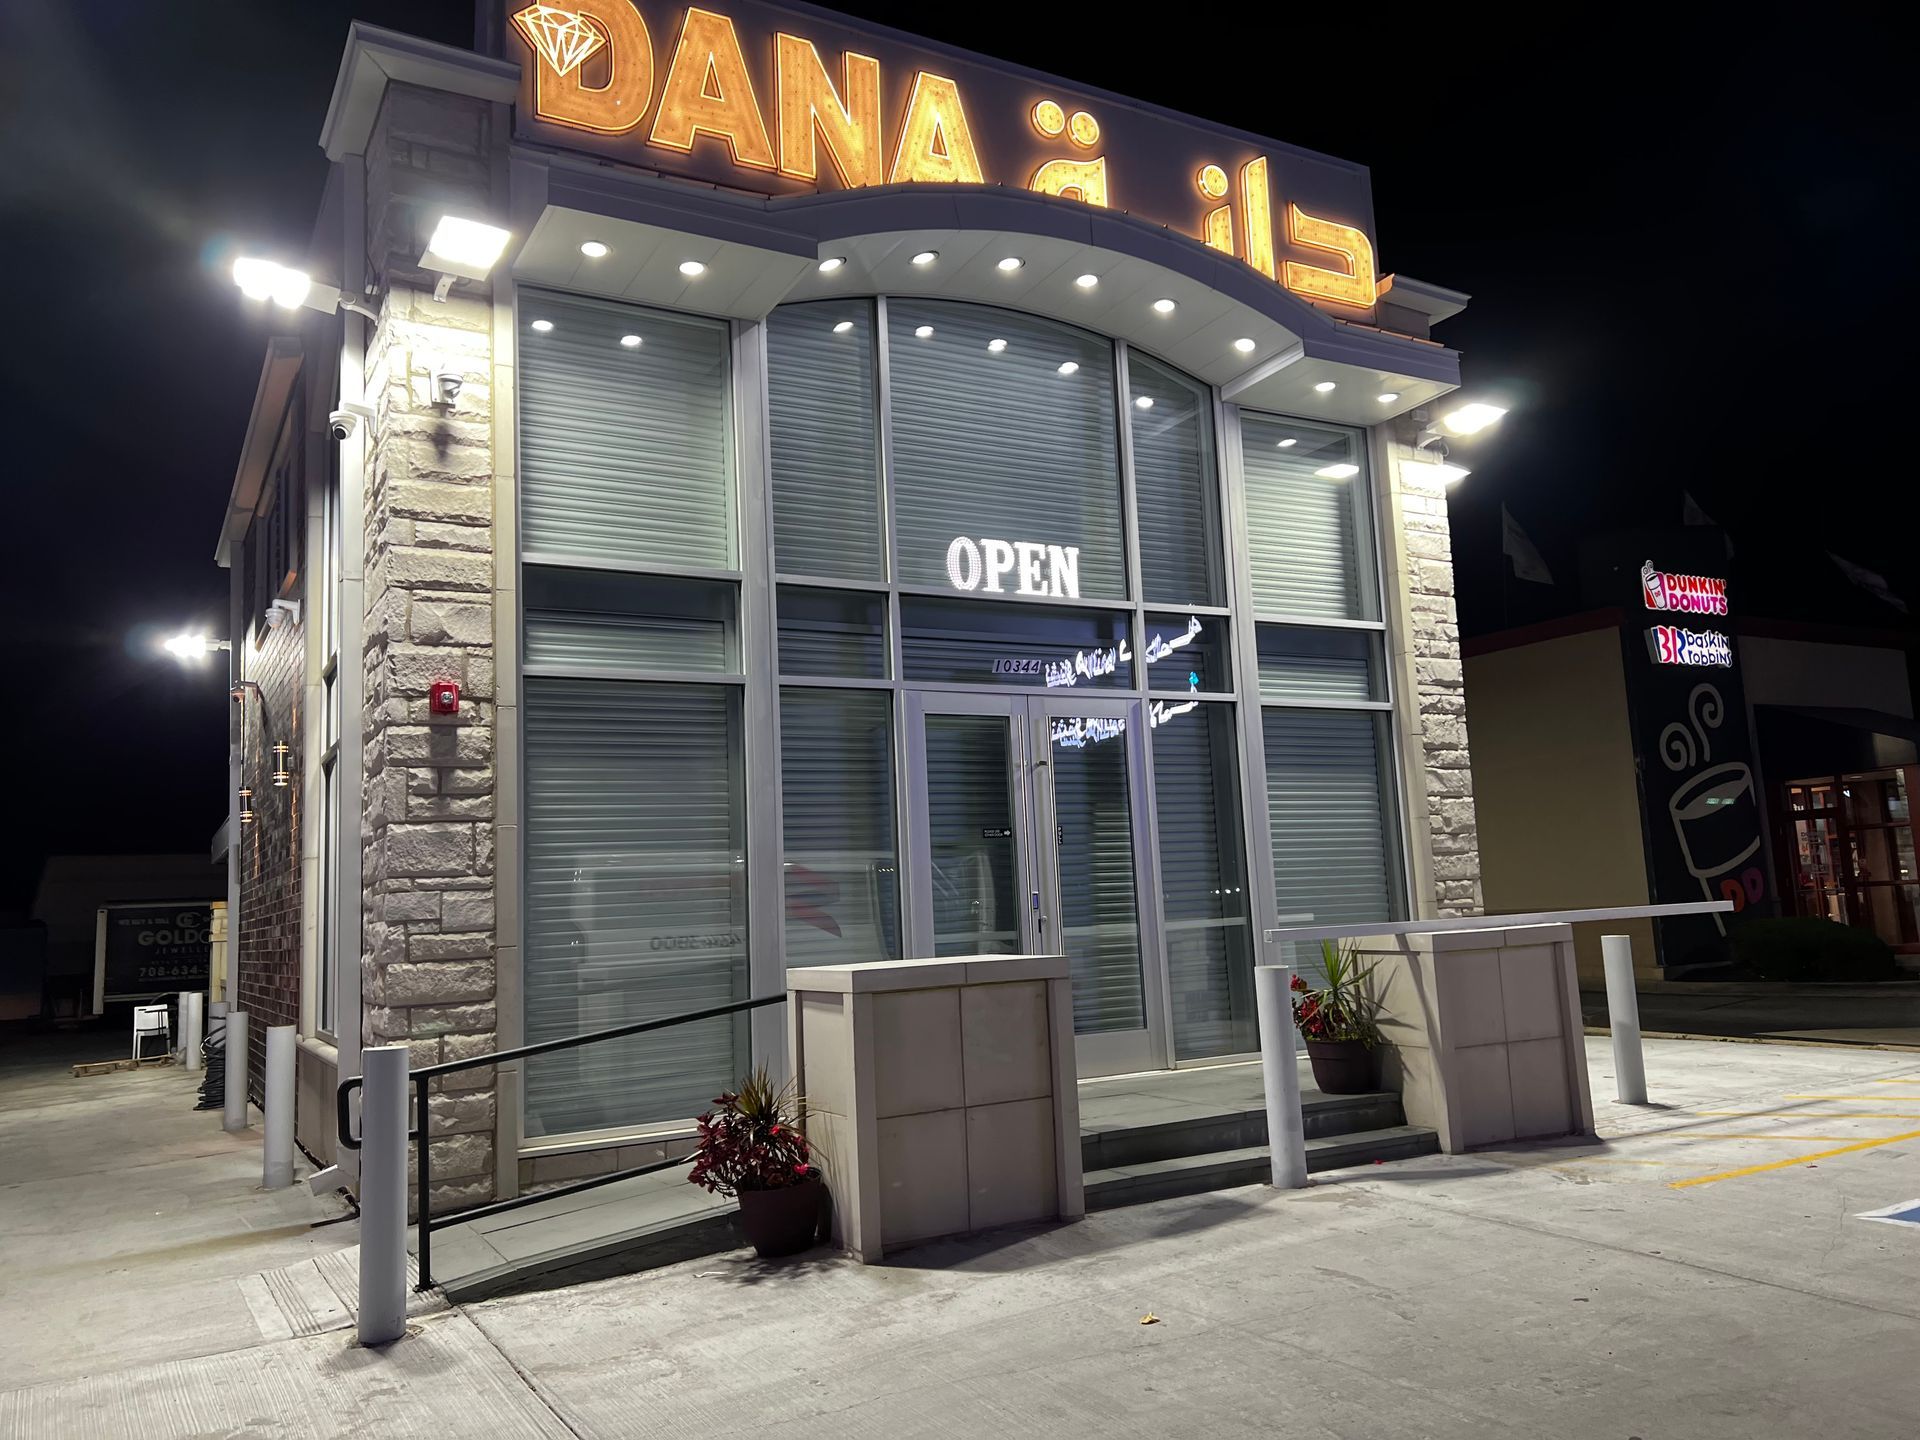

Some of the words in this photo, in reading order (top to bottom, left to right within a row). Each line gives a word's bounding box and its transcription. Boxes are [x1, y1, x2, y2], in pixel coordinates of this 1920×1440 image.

[532, 0, 986, 189] DANA
[946, 536, 1081, 599] OPEN
[1669, 593, 1727, 615] DONUTS
[995, 660, 1040, 673] 10344
